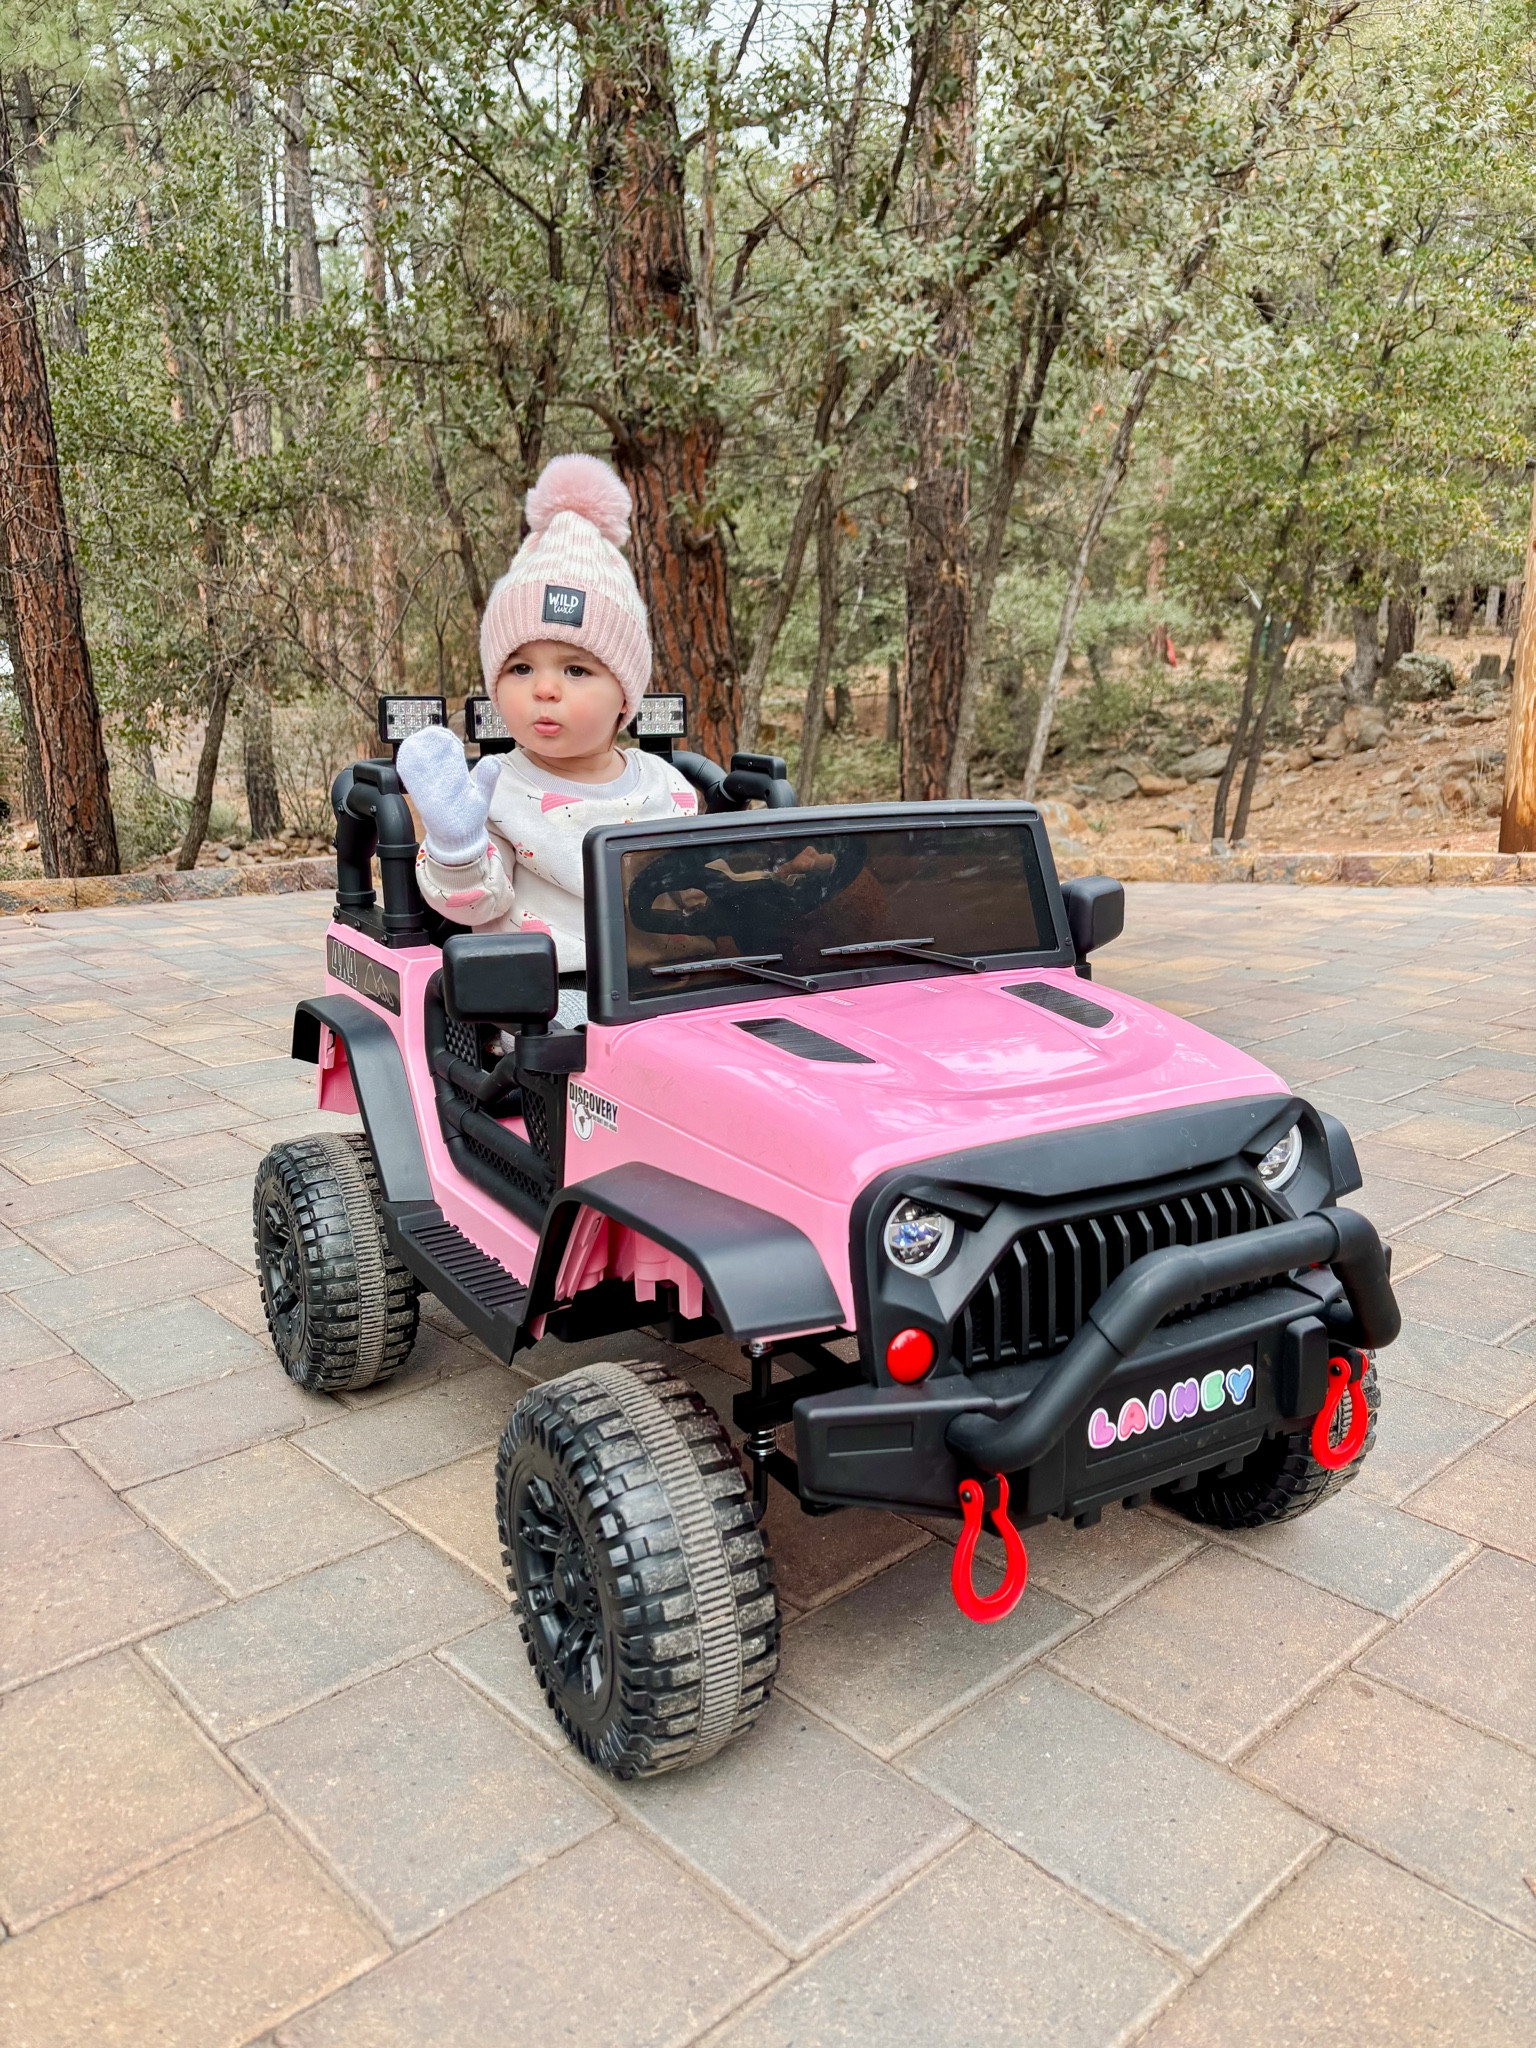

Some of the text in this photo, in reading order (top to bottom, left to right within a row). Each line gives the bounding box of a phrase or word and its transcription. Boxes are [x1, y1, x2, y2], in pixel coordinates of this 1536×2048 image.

[549, 592, 579, 608] WILD
[569, 1081, 618, 1123] DISCOVERY
[1088, 1364, 1254, 1449] LAINEY
